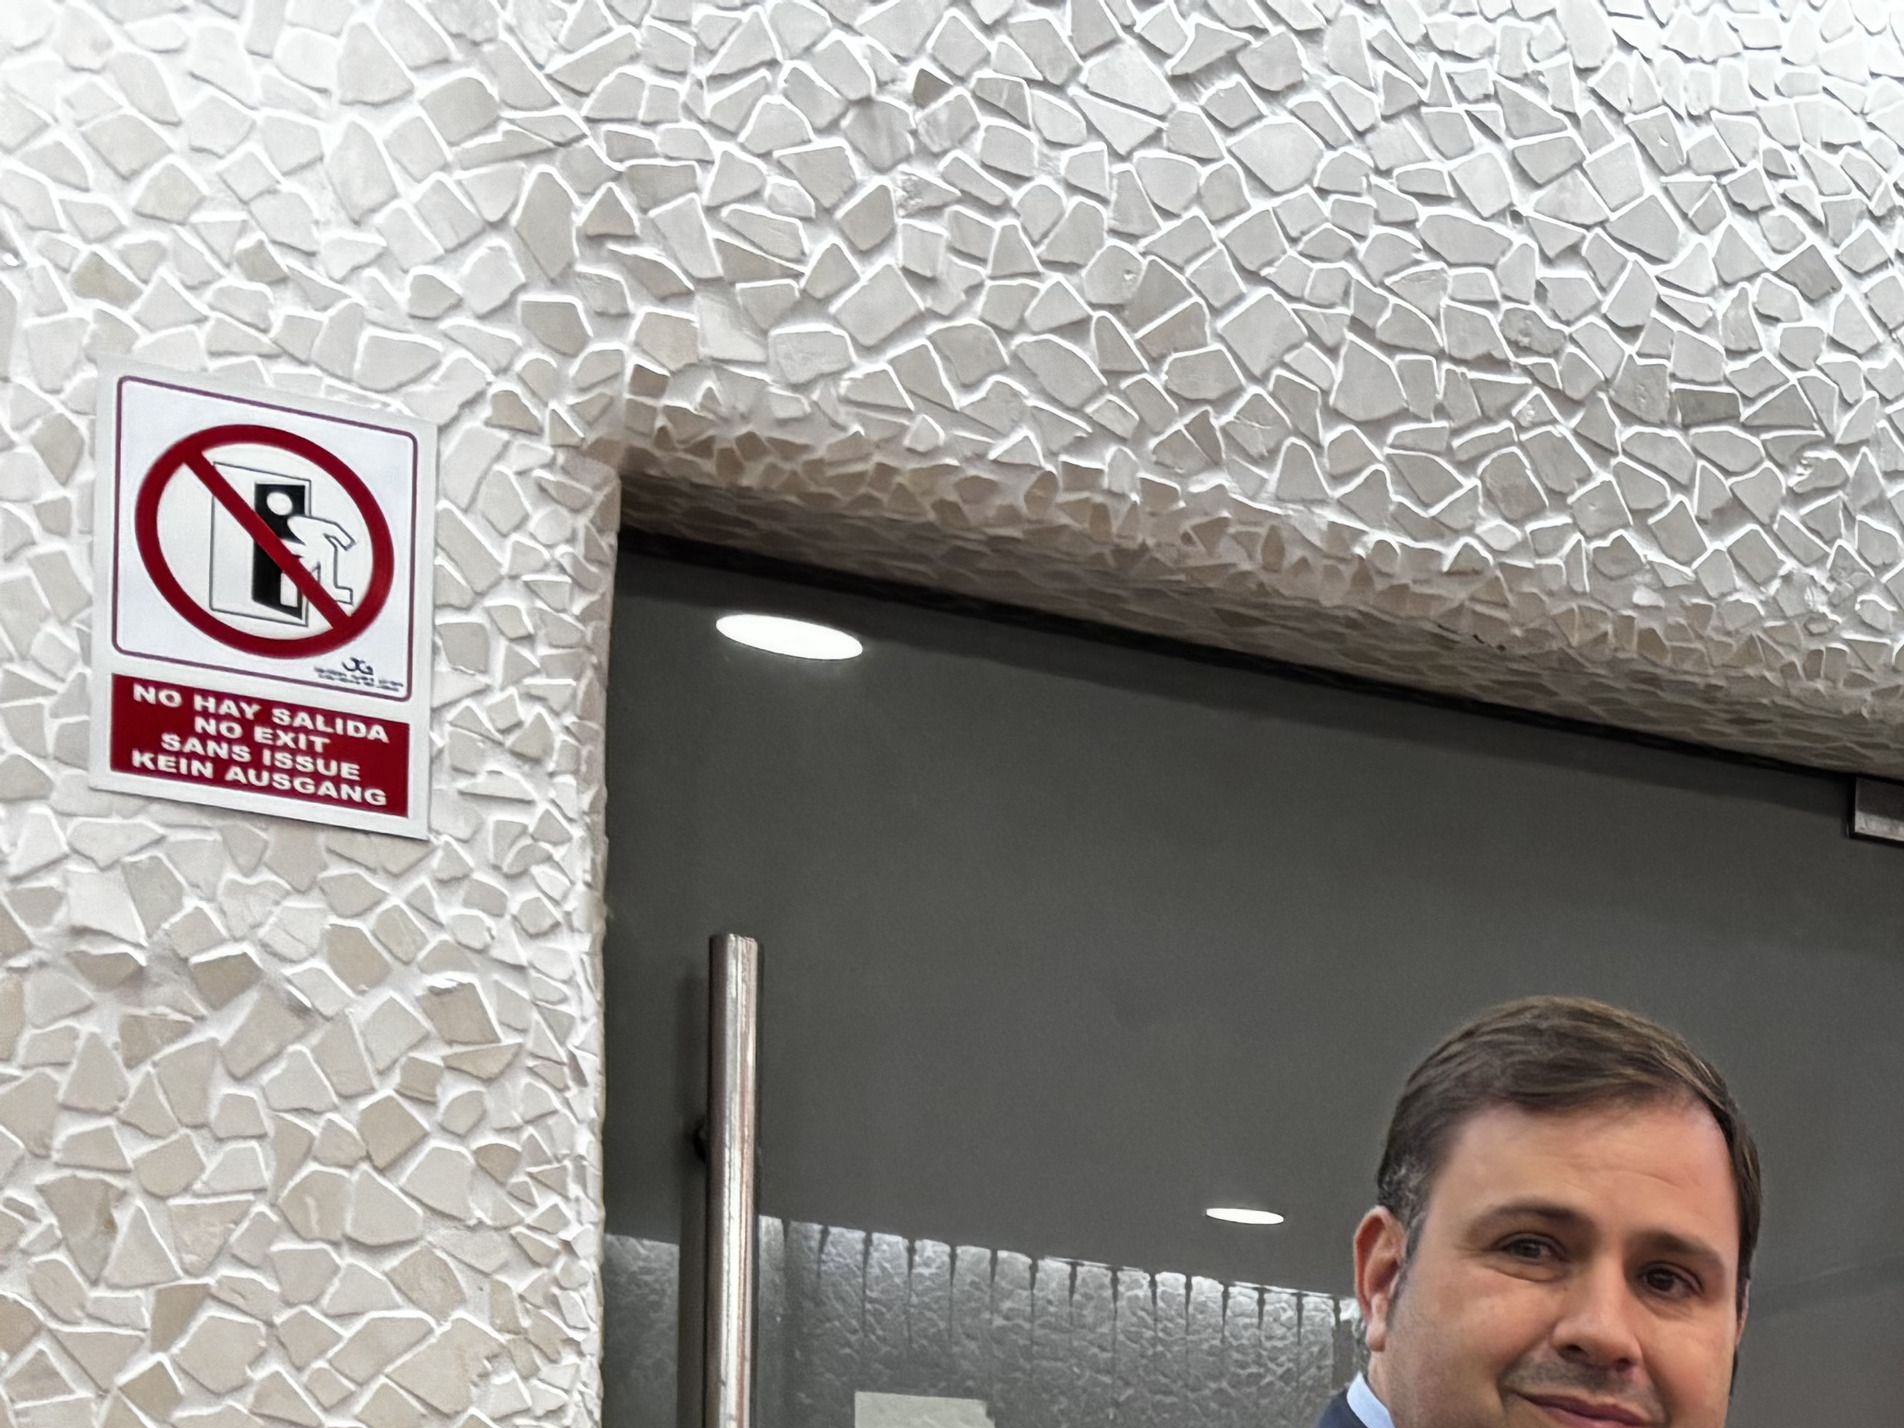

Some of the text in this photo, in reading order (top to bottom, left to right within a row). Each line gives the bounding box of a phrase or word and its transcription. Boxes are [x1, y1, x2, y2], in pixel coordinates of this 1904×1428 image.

[133, 683, 390, 743] NO HAY SALIDA
[194, 716, 331, 753] NO EXIT
[131, 749, 387, 806] KEIN AUSGANG
[161, 732, 361, 781] SANS ISSUE
